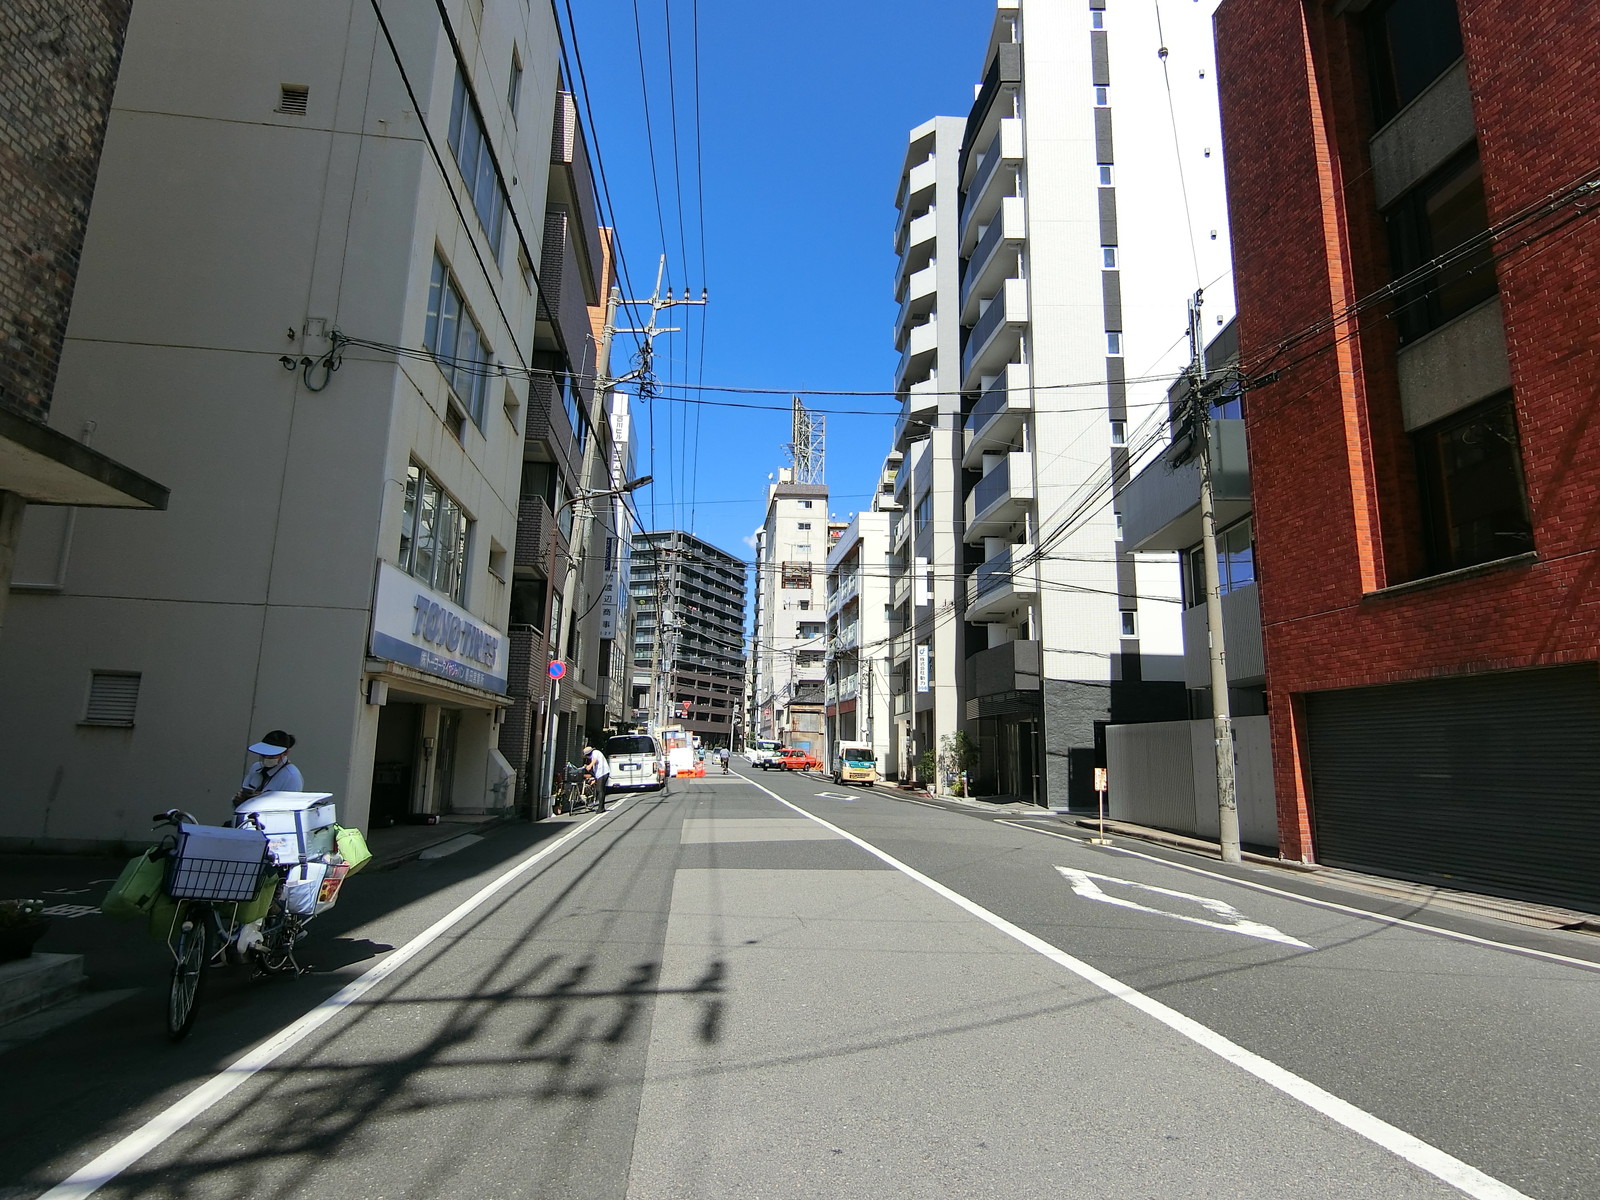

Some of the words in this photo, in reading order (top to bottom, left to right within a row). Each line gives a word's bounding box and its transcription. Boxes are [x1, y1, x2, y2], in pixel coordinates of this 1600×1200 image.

[411, 594, 462, 652] TOYO
[459, 620, 499, 668] TIRES
[602, 584, 613, 629] 渡辺商事
